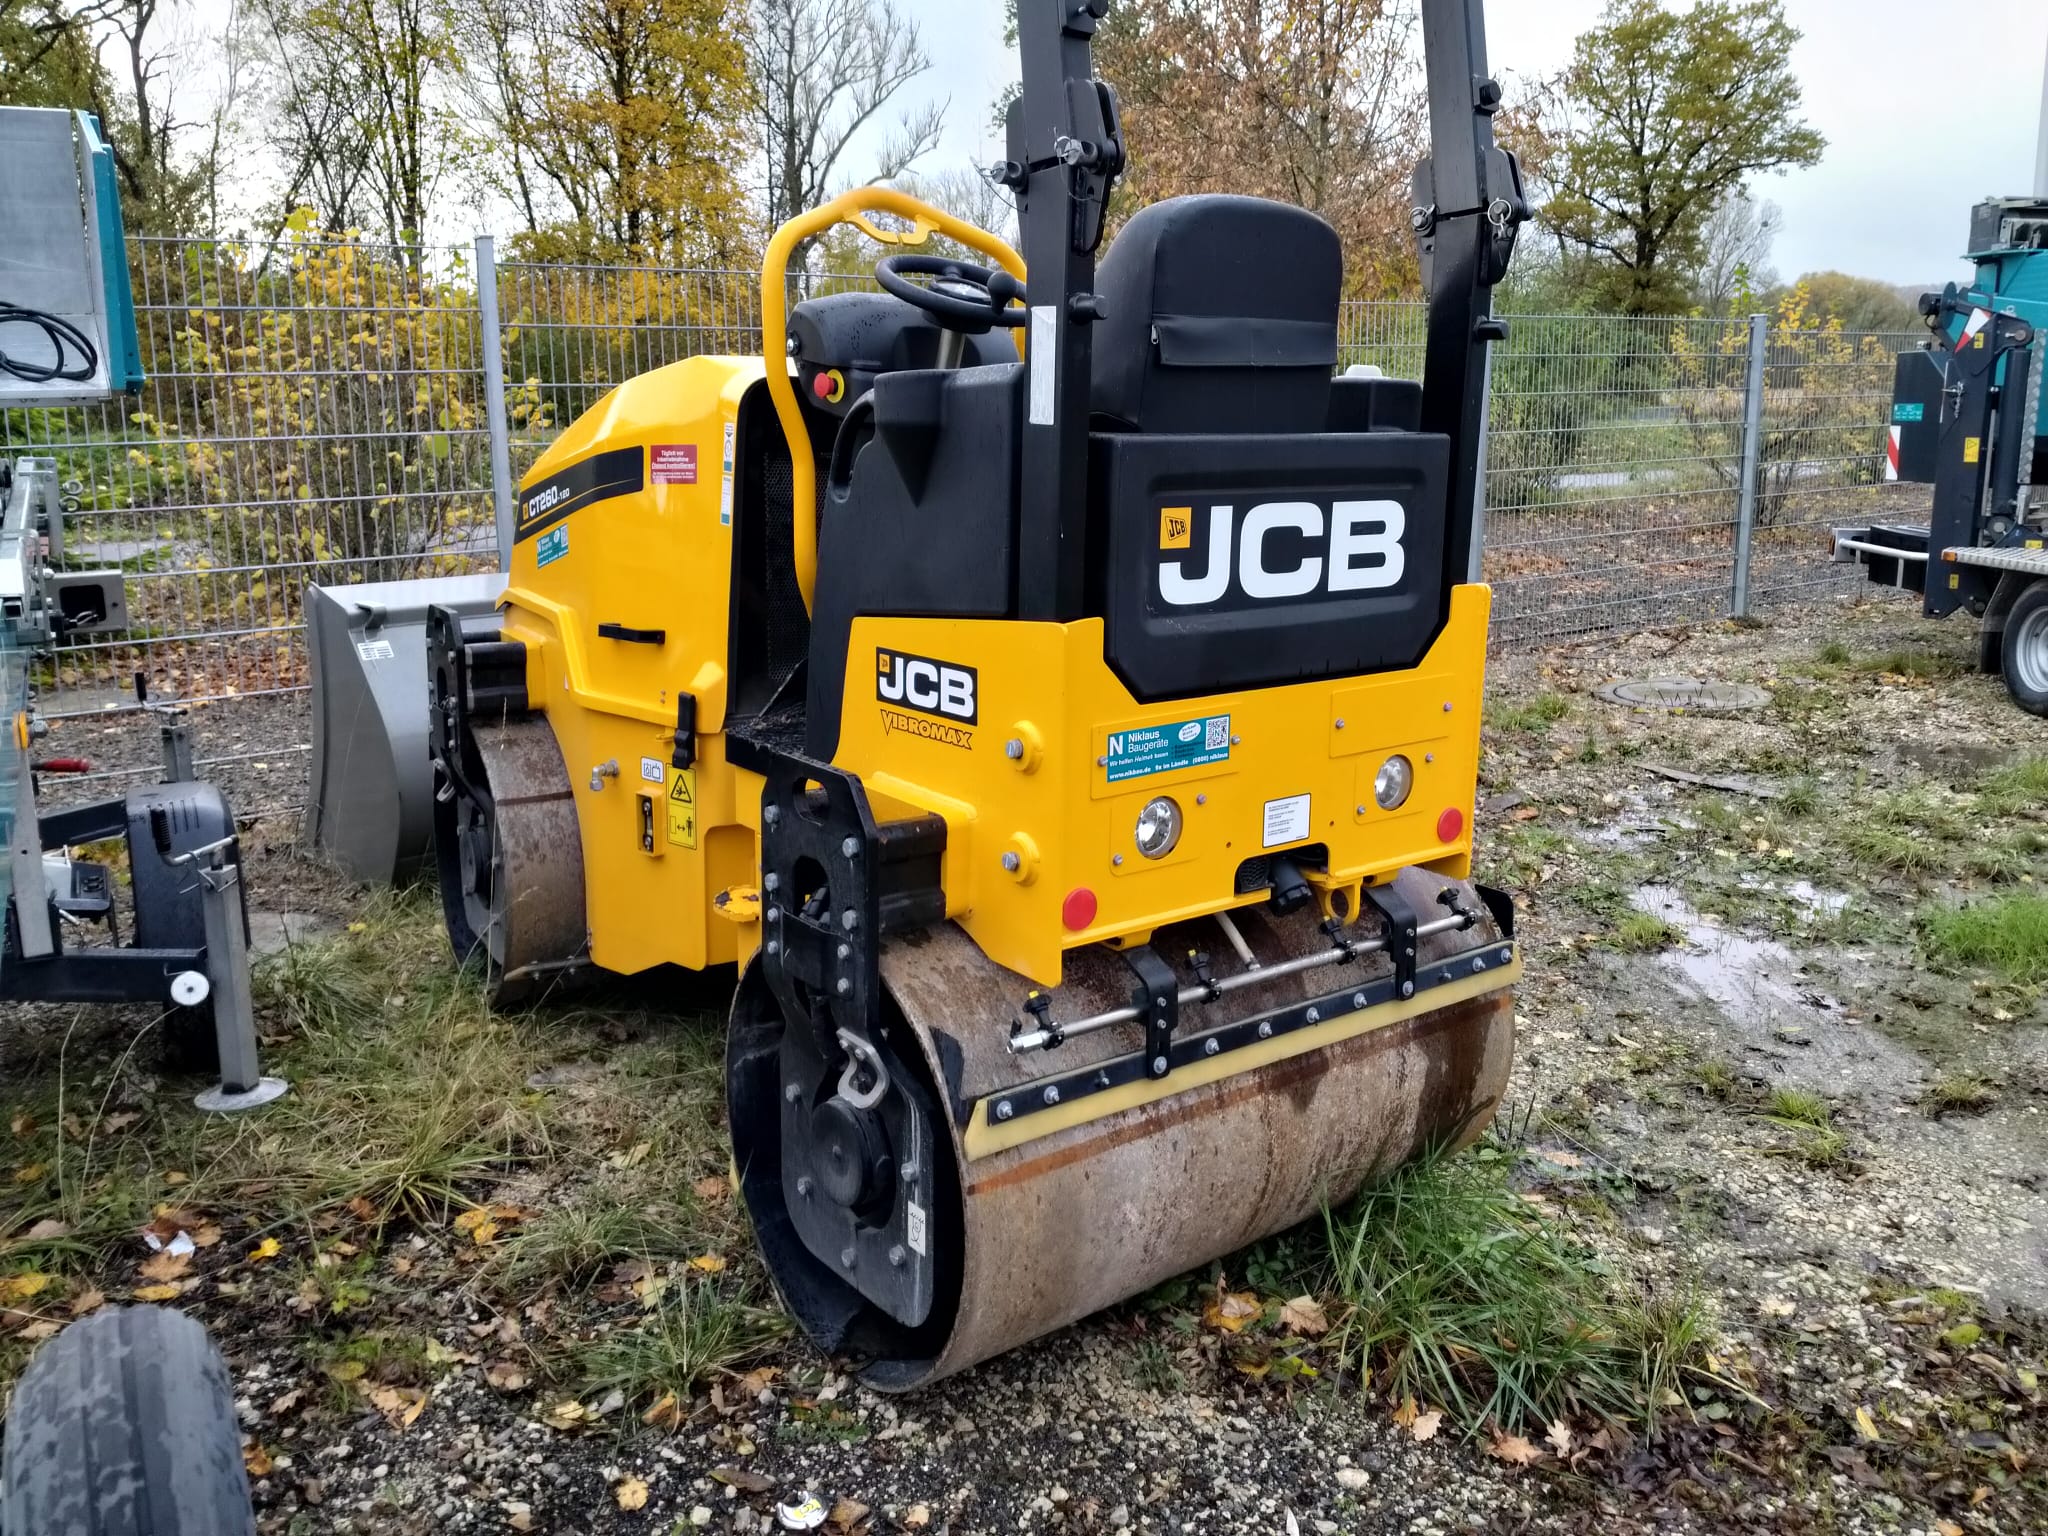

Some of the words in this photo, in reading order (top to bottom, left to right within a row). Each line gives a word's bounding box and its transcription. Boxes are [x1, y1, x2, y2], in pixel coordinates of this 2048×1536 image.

[1168, 518, 1186, 538] JCB
[1159, 499, 1406, 605] JCB
[879, 656, 974, 718] JCB
[880, 708, 973, 750] VIBROMAX
[1128, 730, 1160, 743] Niklaus
[1109, 734, 1124, 757] N
[1128, 739, 1169, 753] Baugeräte
